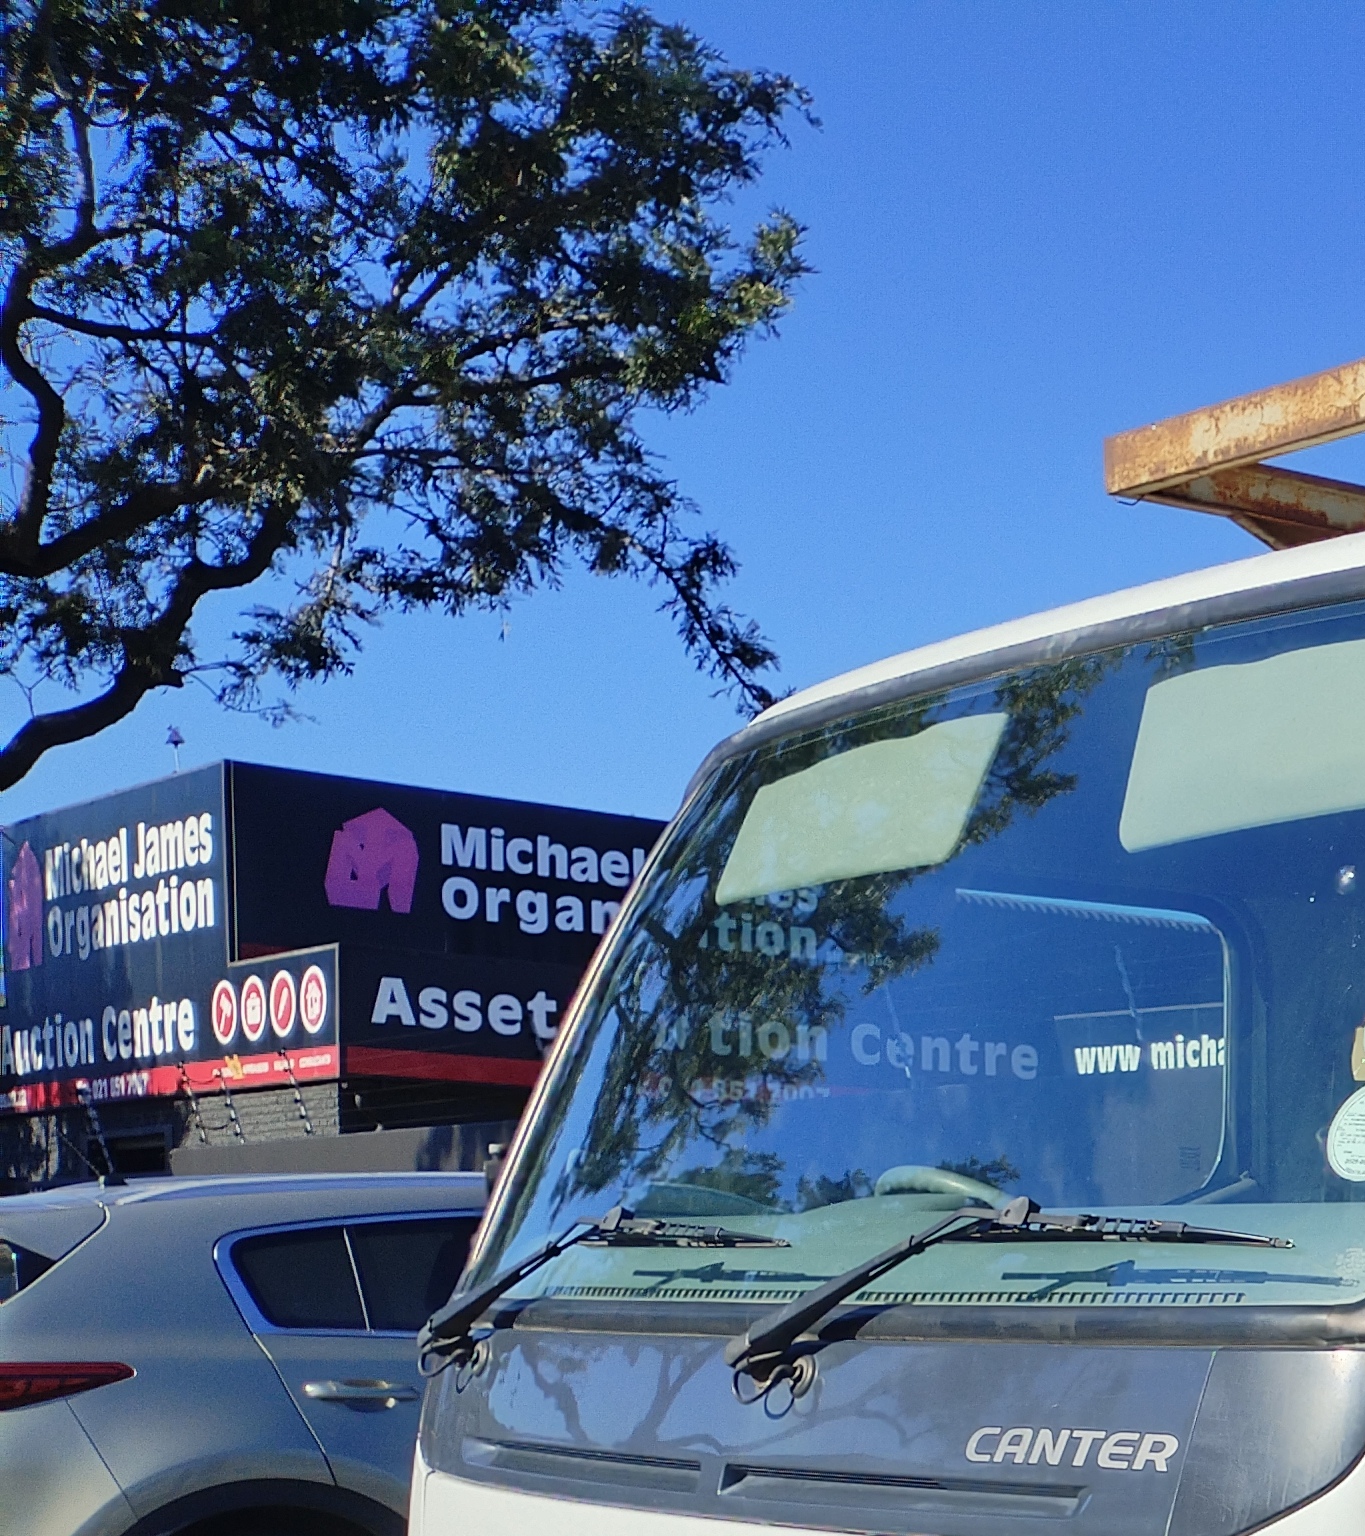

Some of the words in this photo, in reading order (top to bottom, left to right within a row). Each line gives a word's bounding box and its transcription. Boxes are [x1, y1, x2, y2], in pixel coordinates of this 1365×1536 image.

[45, 827, 128, 901] Michael
[134, 812, 213, 879] James
[440, 823, 646, 887] Michael
[47, 875, 214, 961] Organisation
[700, 911, 818, 962] tion
[1, 1012, 95, 1076] Auction
[102, 996, 195, 1062] Centre
[370, 976, 558, 1039] Asset
[851, 1023, 1039, 1080] Centre
[964, 1425, 1180, 1473] CANTER
